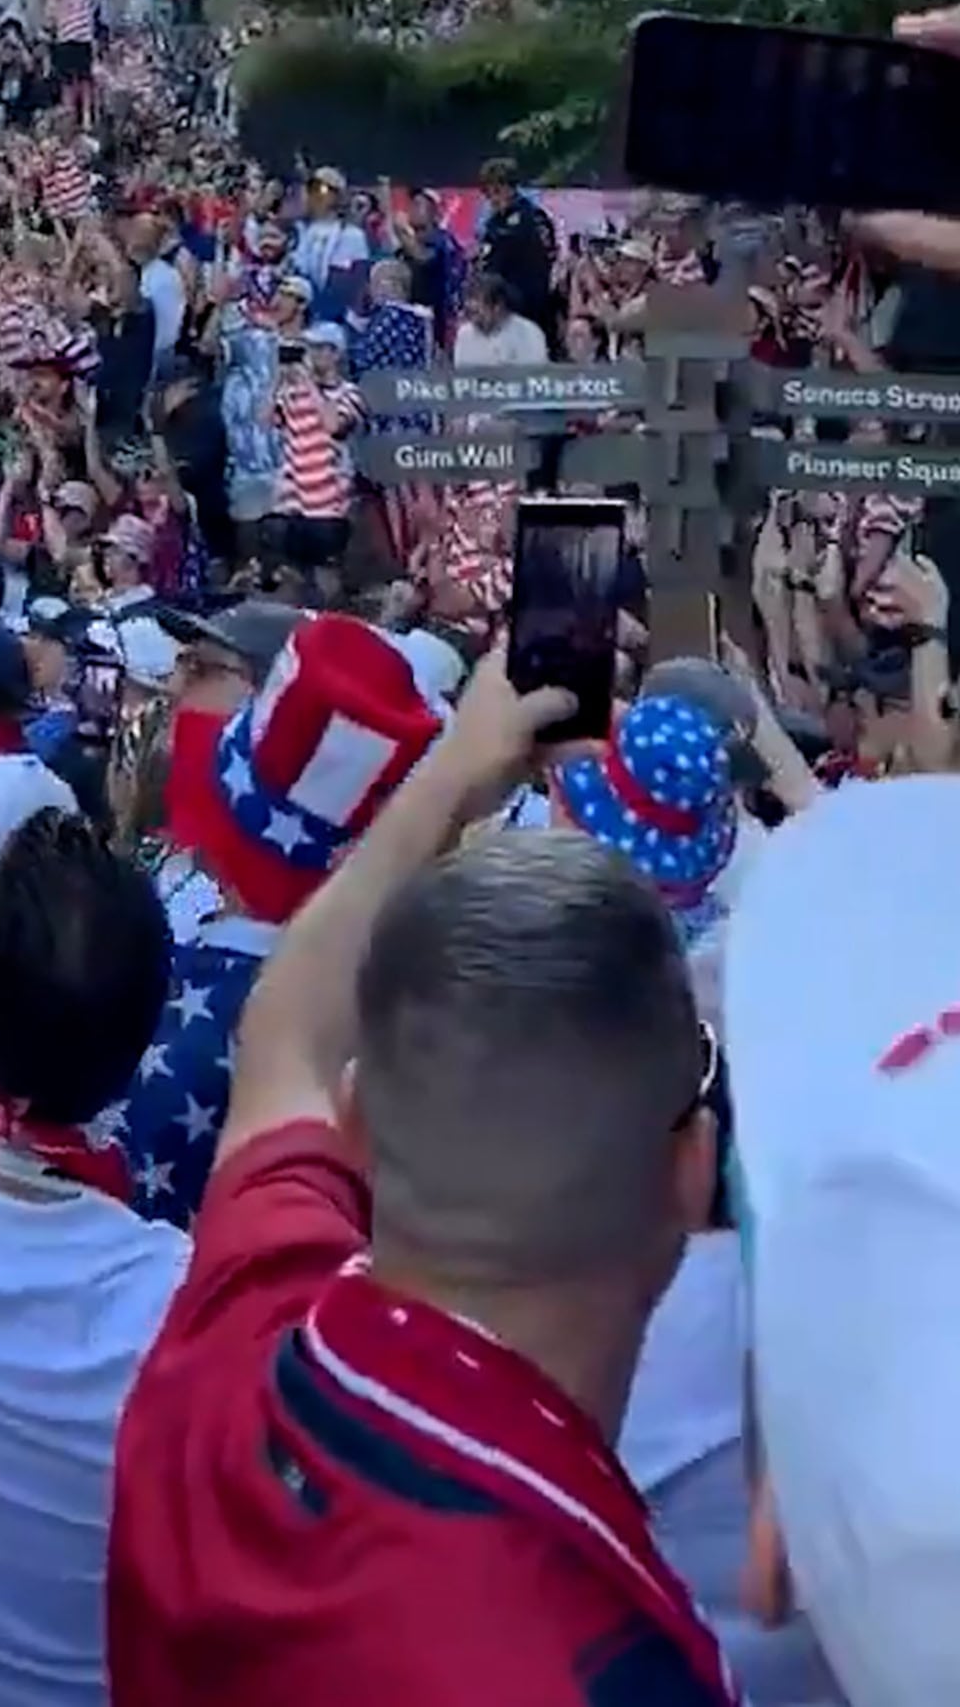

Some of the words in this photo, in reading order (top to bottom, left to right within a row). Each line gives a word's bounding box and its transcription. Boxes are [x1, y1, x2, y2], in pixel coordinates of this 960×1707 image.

[395, 378, 448, 401] Pike
[452, 378, 521, 399] Place
[526, 374, 624, 398] Market
[782, 379, 881, 407] Seneca
[394, 444, 453, 469] Gum
[457, 444, 514, 468] Wall
[787, 451, 891, 479] Pioneer
